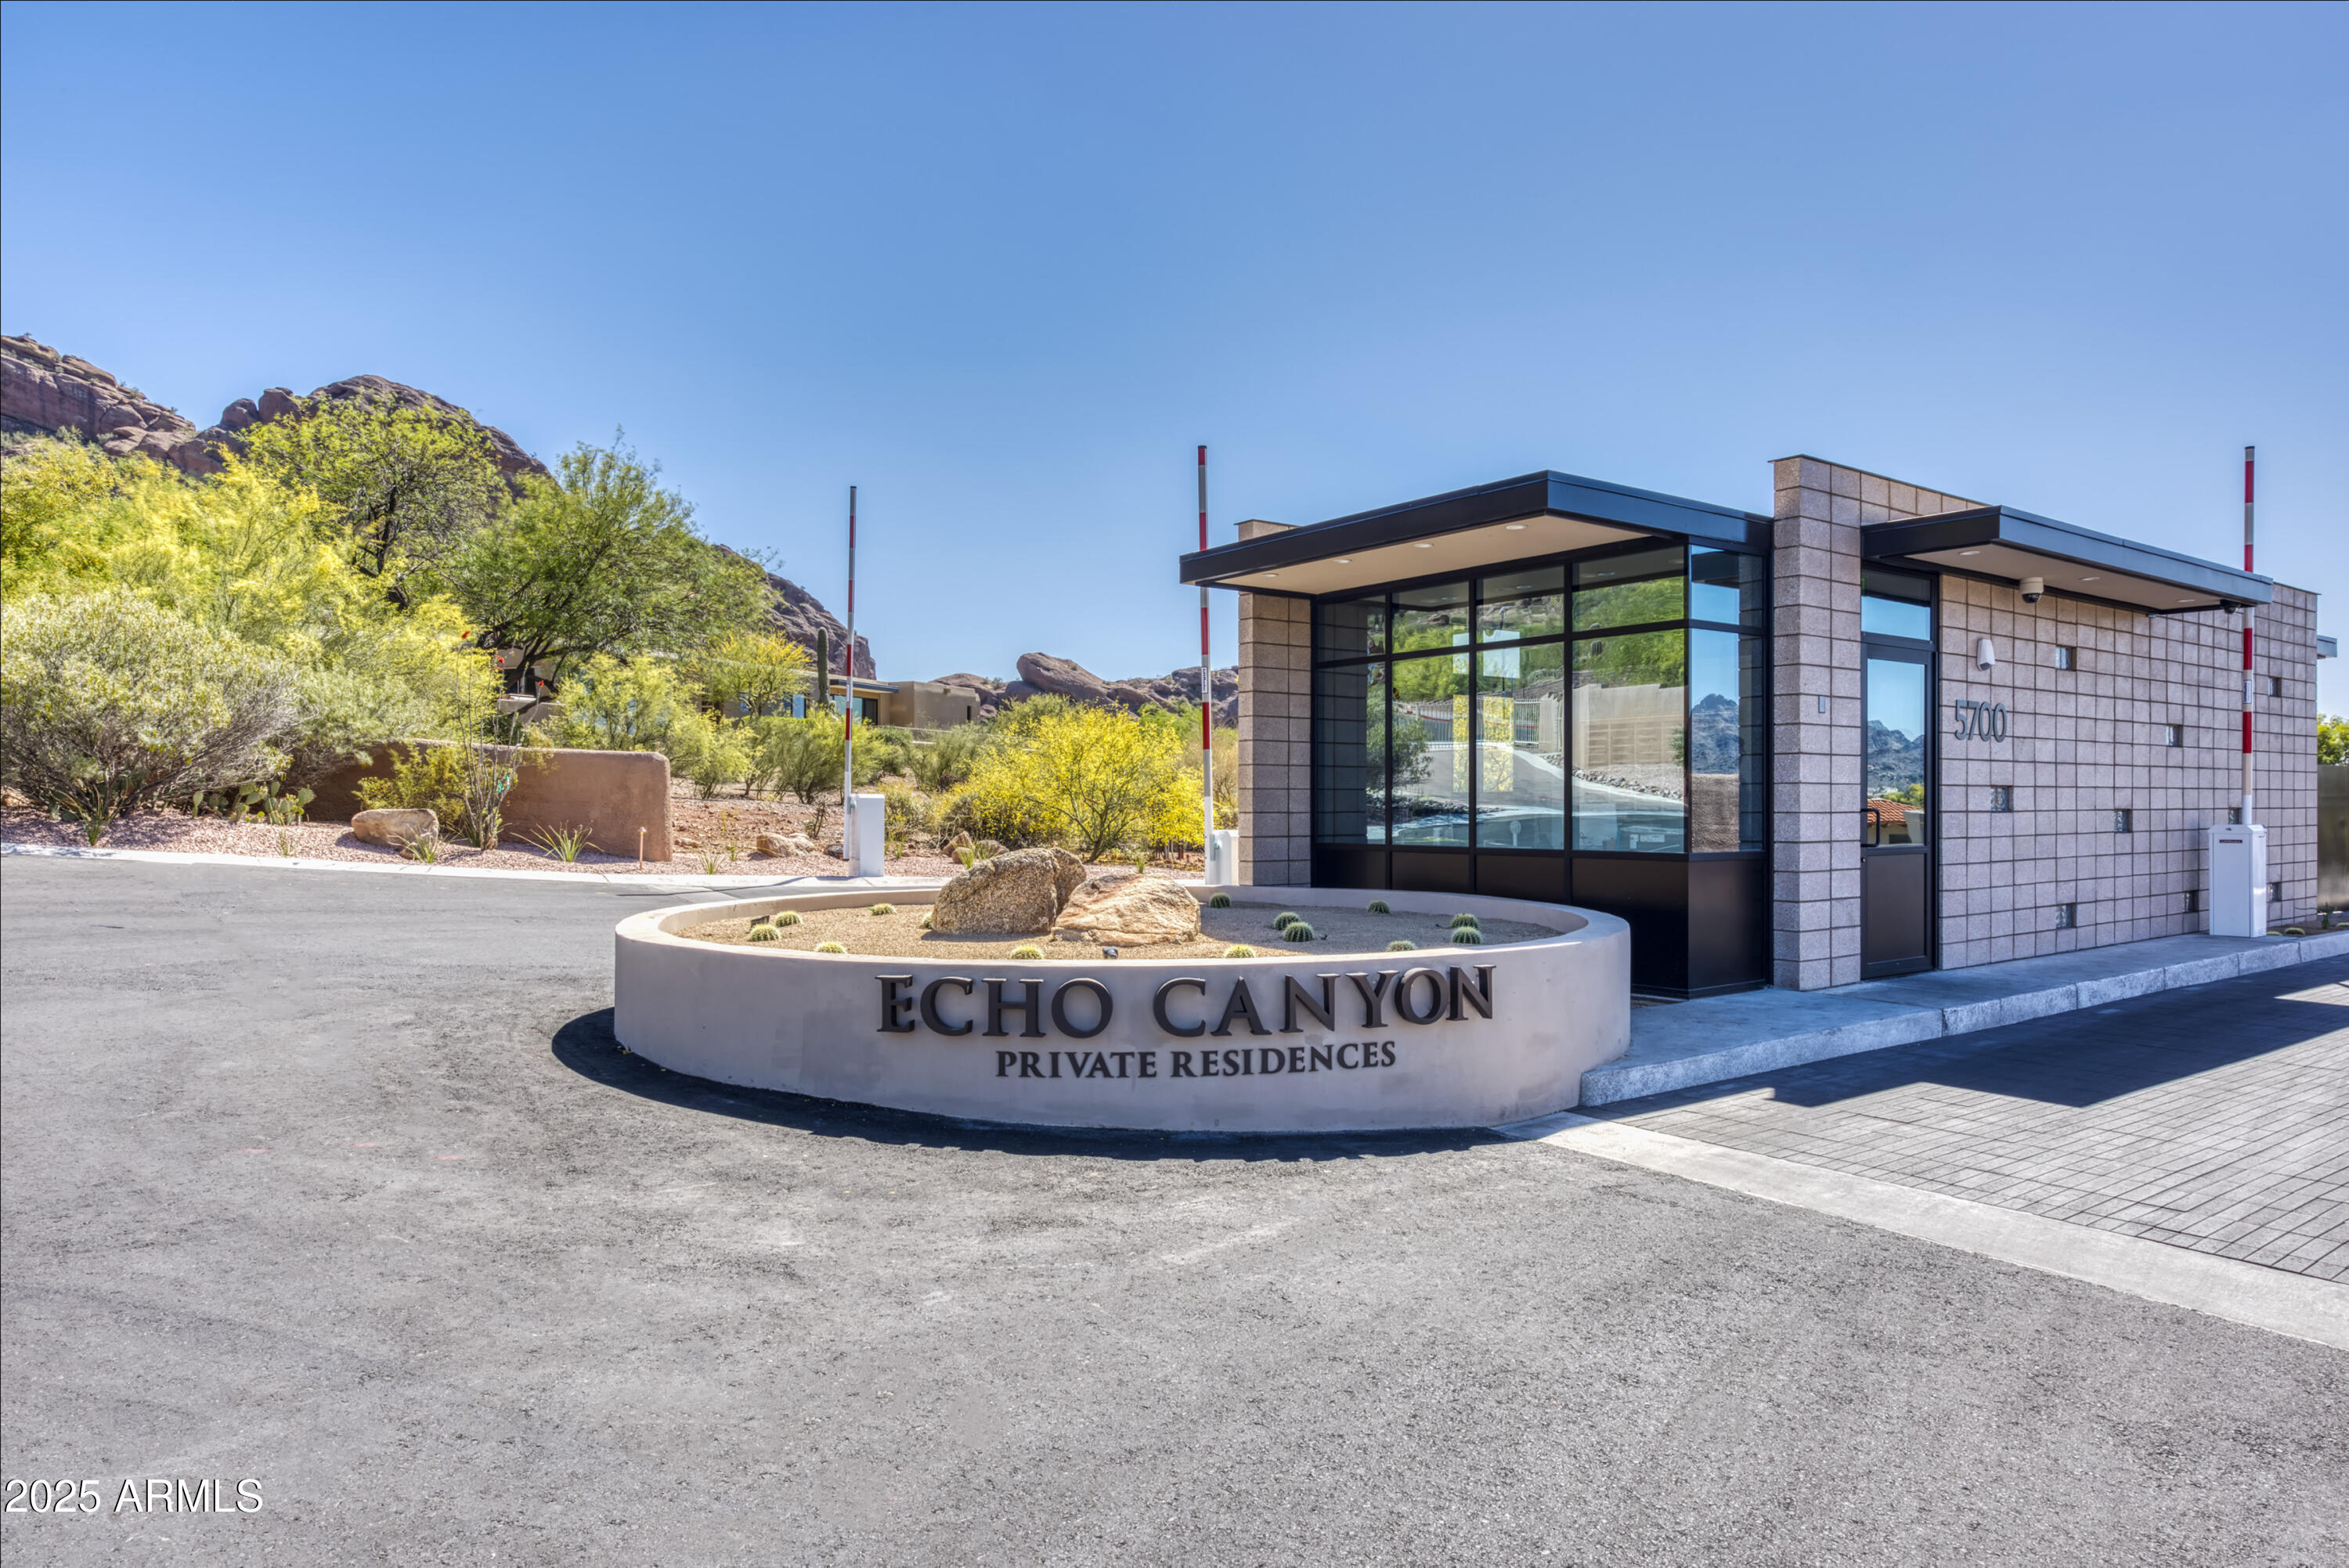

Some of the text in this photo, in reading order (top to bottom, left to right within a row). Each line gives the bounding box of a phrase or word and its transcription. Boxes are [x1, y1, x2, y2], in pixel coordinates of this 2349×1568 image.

[1954, 699, 2008, 743] 5700
[876, 964, 1497, 1038] ECHO CANYON
[995, 1041, 1397, 1079] PRIVATE RESIDENCES
